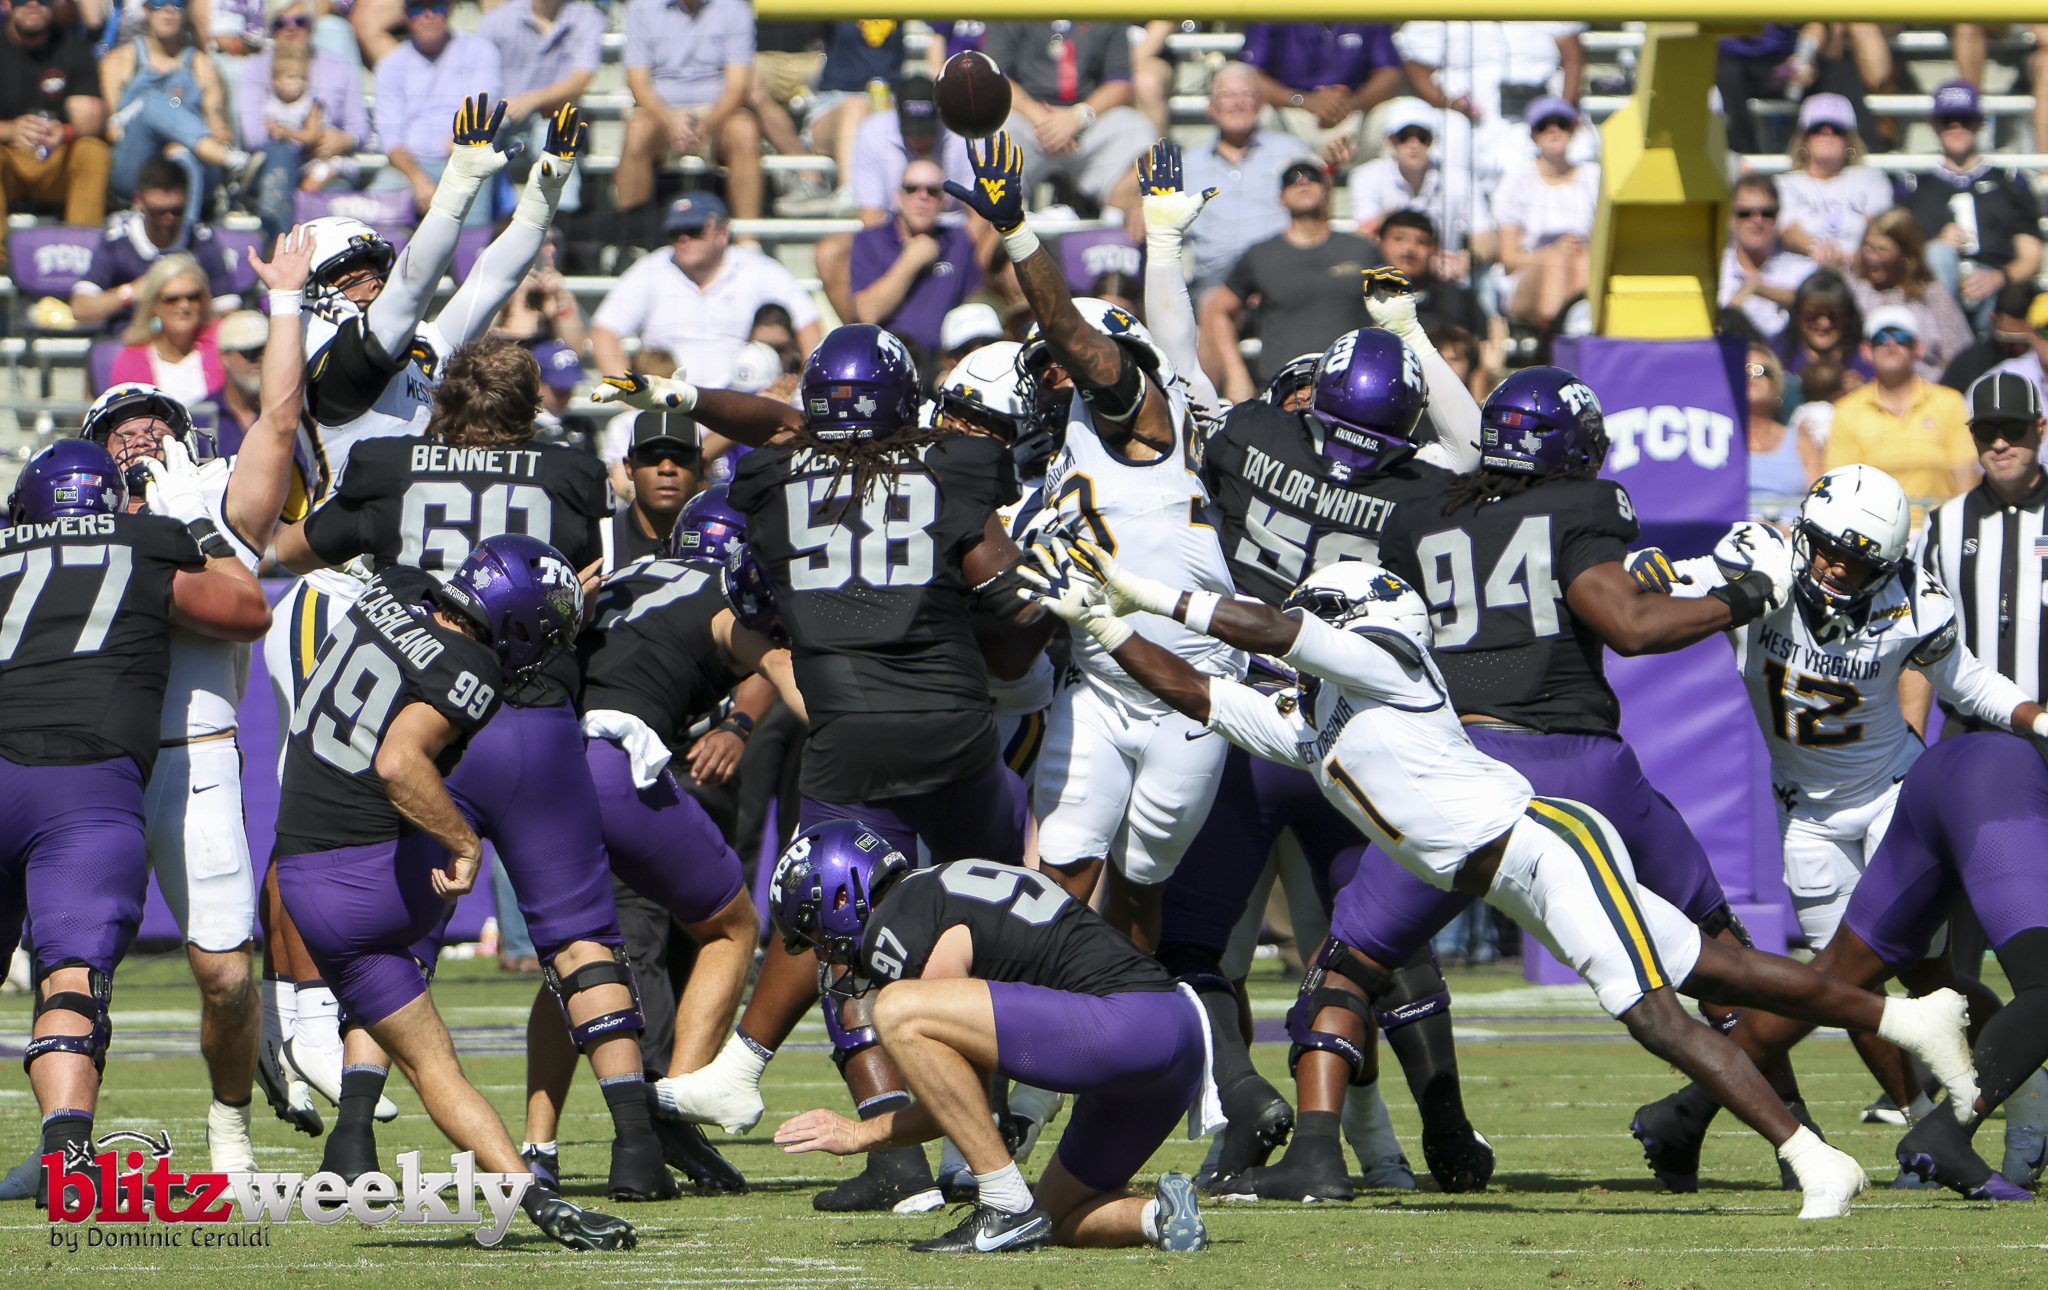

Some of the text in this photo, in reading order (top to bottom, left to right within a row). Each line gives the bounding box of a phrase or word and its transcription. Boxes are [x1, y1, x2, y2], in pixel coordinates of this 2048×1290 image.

[406, 374, 434, 406] WES
[411, 445, 542, 477] BENNETT
[1603, 404, 1734, 474] TCU
[0, 513, 116, 549] POWERS
[784, 473, 939, 592] 58
[1616, 488, 1638, 522] 9
[402, 480, 553, 591] 60
[0, 543, 134, 661] 77
[1416, 514, 1563, 648] 94
[1758, 624, 1881, 680] WEST VIRGINIA
[448, 670, 495, 720] 99
[1762, 657, 1863, 748] 12
[1326, 755, 1404, 845] 1
[871, 926, 908, 980] 97
[588, 1017, 626, 1034] DONJOY
[1400, 1001, 1437, 1019] DONJOY
